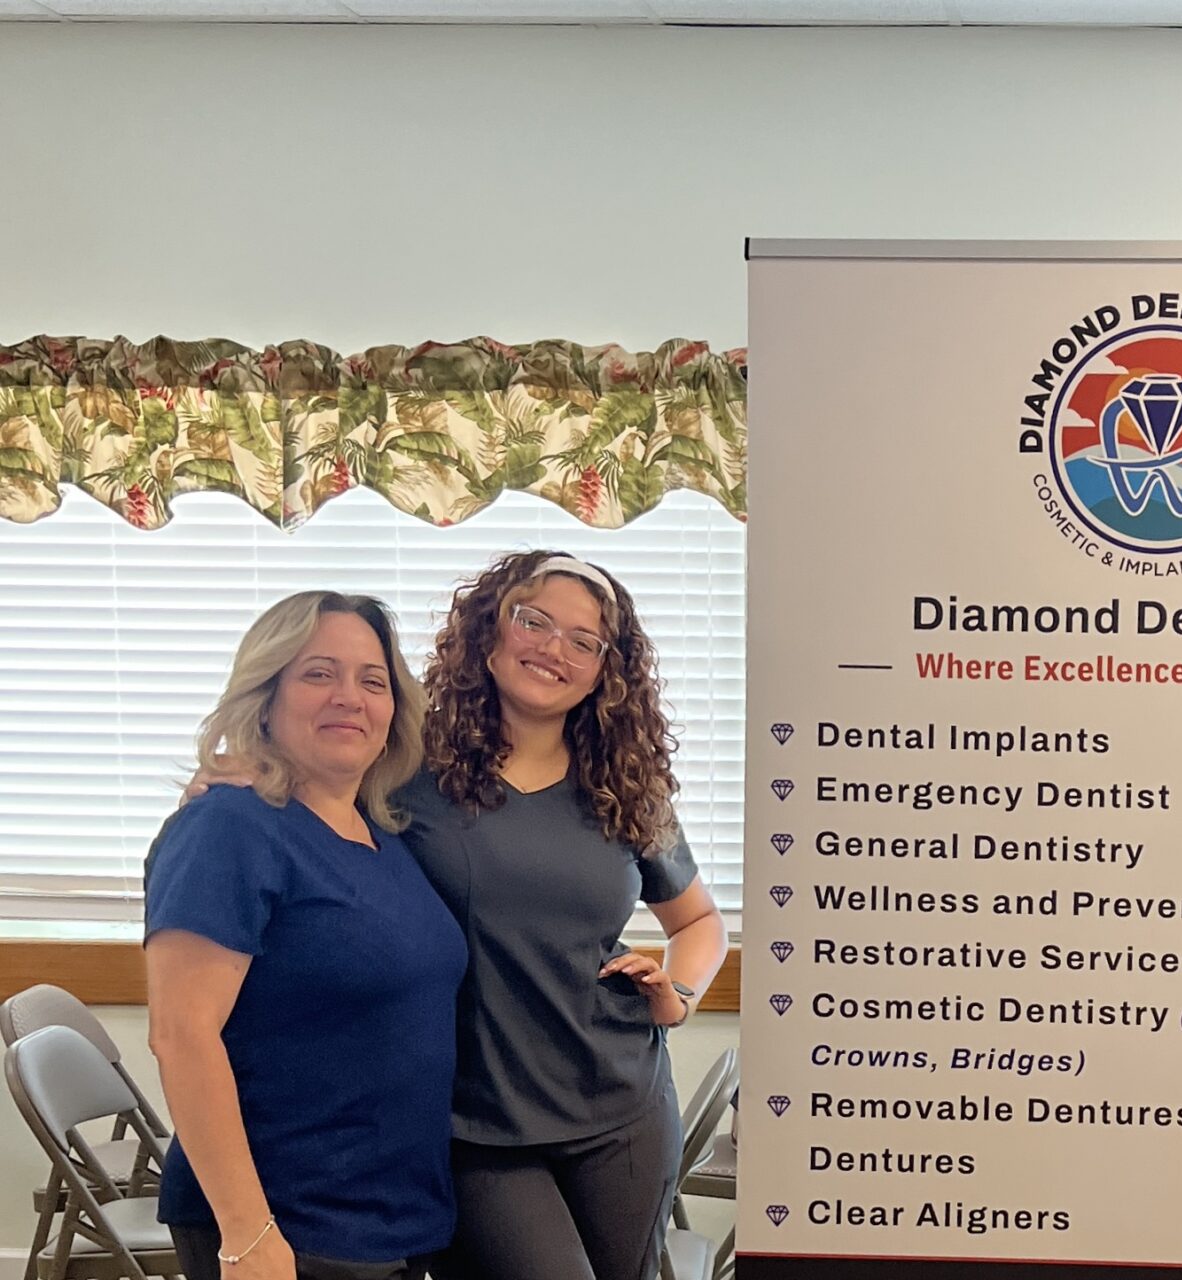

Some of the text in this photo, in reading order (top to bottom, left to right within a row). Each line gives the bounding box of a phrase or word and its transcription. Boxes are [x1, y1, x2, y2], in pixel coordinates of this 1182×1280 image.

[1019, 304, 1121, 453] DIAMOND
[1033, 473, 1099, 557] COSMETIC
[1101, 551, 1113, 566] &
[912, 595, 1121, 634] Diamond
[916, 652, 1014, 682] Where
[816, 721, 1111, 758] Dental Implants
[816, 776, 1171, 811] Emergency Dentist
[815, 830, 1145, 869] General Dentistry
[813, 885, 980, 915] Wellness
[992, 889, 1058, 917] and
[813, 939, 1028, 970] Restorative
[811, 992, 986, 1022] Cosmetic
[999, 997, 1169, 1032] Dentistry
[810, 1044, 1086, 1078] Crowns, Bridges)
[809, 1092, 1014, 1123] Removable
[809, 1145, 976, 1176] Dentures
[807, 1199, 1071, 1235] Clear Aligners
